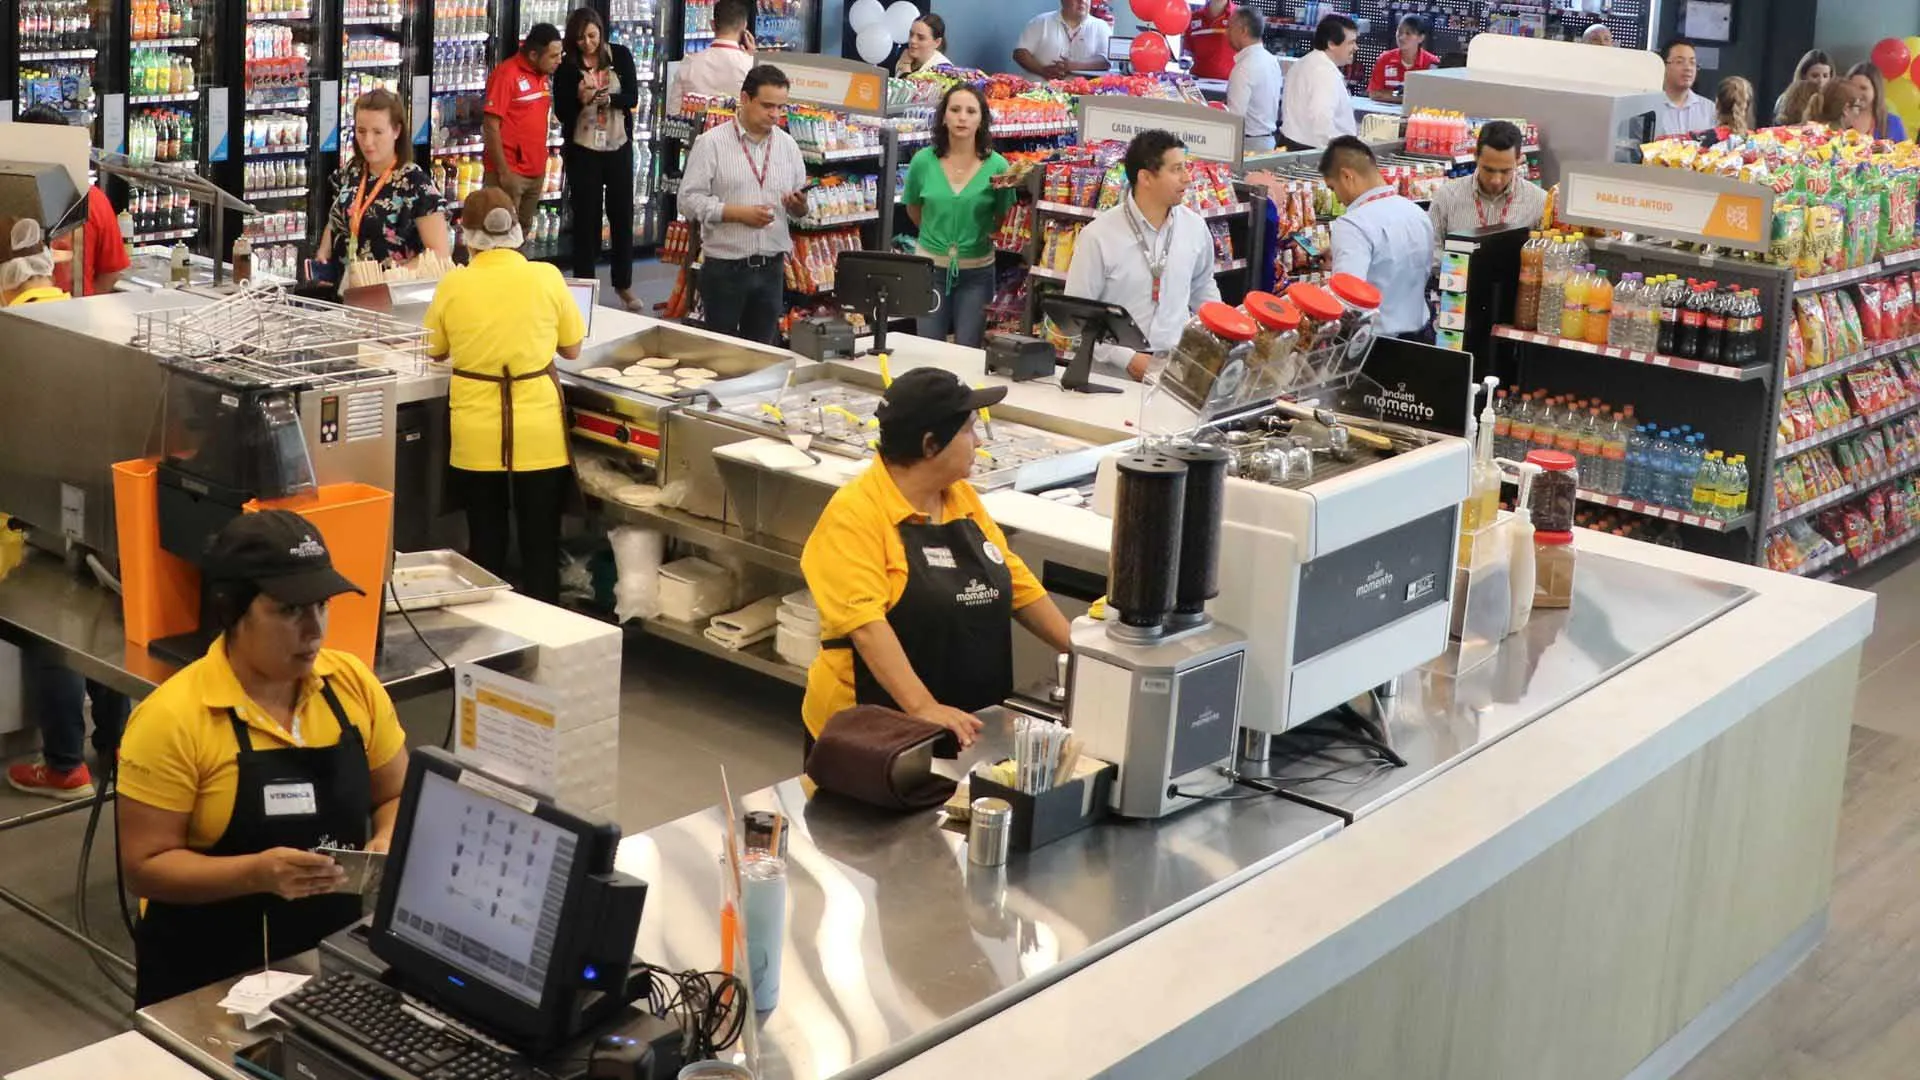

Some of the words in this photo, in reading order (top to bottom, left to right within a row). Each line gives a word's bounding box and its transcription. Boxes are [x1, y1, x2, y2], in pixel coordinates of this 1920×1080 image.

[1112, 123, 1132, 134] CADA
[1182, 131, 1206, 145] ÚNICA
[1639, 198, 1673, 212] ANTOJO
[1364, 394, 1434, 417] momento
[956, 587, 999, 602] momento
[1356, 572, 1393, 598] momento
